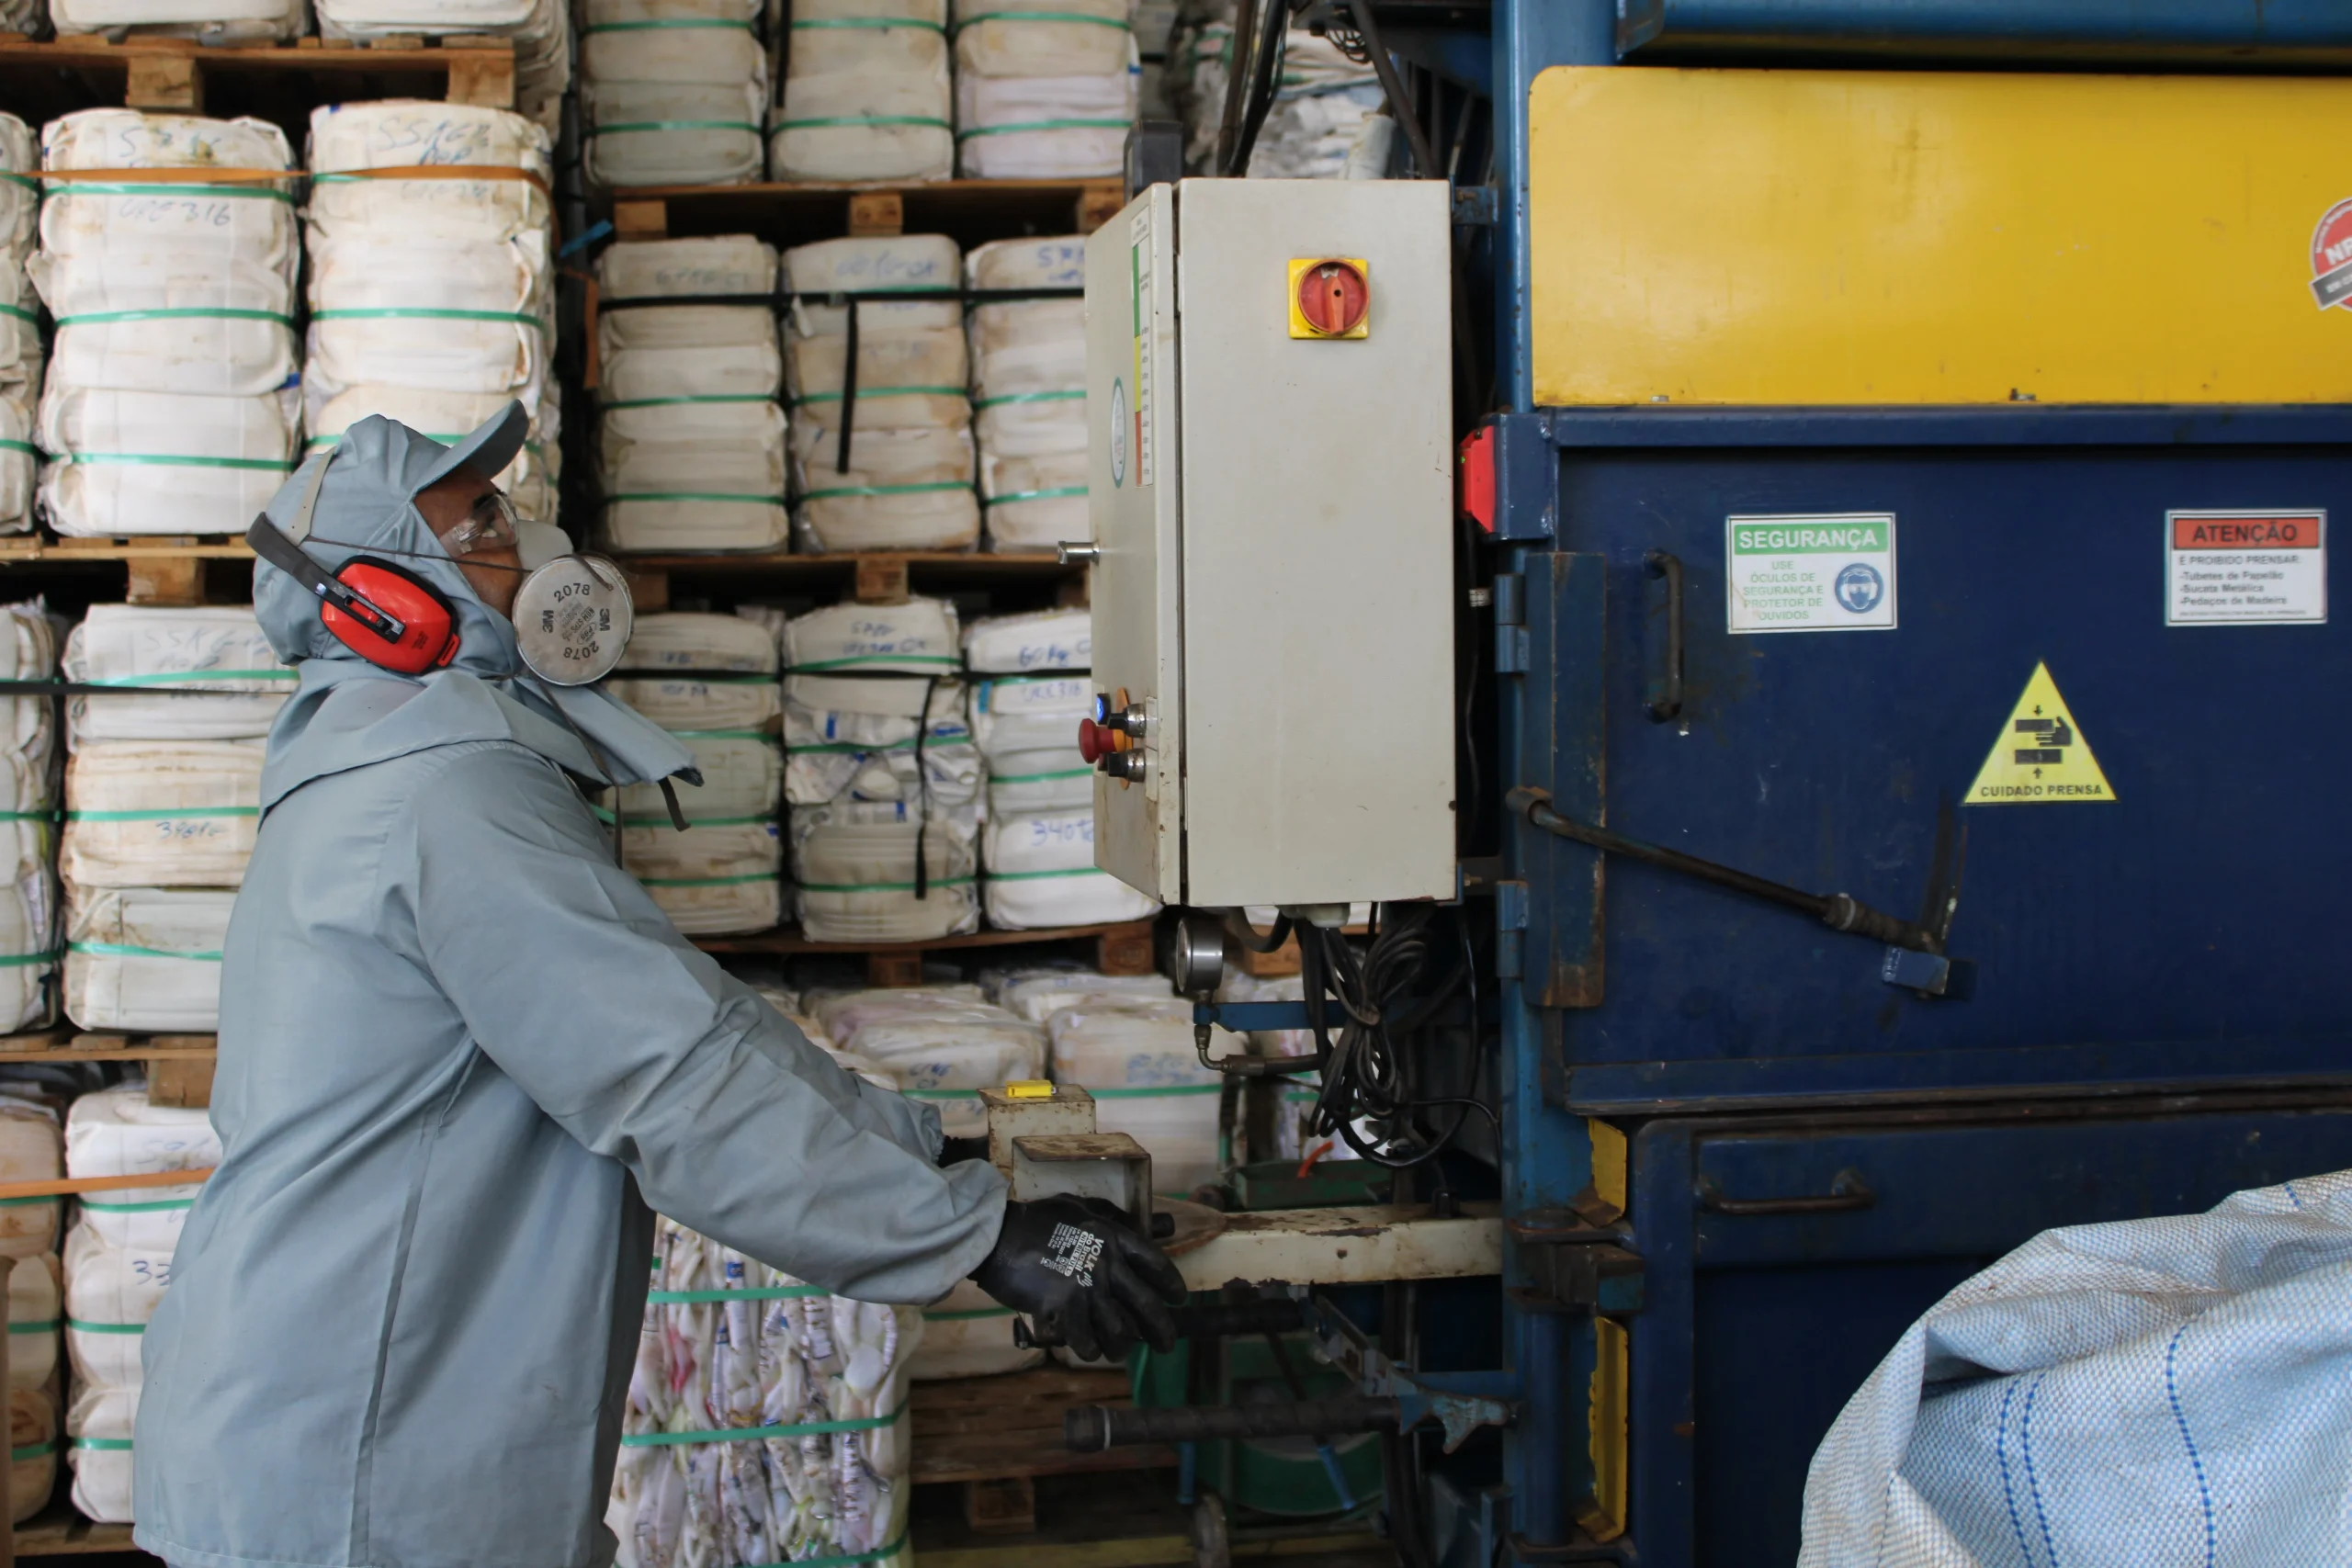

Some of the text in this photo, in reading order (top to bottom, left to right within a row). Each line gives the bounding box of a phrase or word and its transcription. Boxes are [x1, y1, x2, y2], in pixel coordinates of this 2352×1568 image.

[1739, 529, 1878, 550] SEGURANÇA
[2192, 521, 2298, 546] ATENÇÃO
[1771, 560, 1794, 570] USE
[2189, 555, 2244, 565] PROIBIDO
[1750, 570, 1815, 583] ÓCULOS DE
[2227, 571, 2239, 581] de
[2243, 570, 2284, 582] Papelão
[554, 583, 591, 603] 2078
[1743, 584, 1824, 597] SEGURANÇA E
[2222, 582, 2265, 593] Metálica
[1745, 598, 1824, 609] PROTETOR DE
[2231, 596, 2243, 605] de
[2246, 595, 2288, 605] Madeira
[542, 610, 555, 634] 3M
[599, 608, 611, 632] 3M
[1758, 610, 1810, 621] OUVIDOS
[563, 640, 600, 660] 2078
[1981, 784, 2103, 797] CUIDADO PRENSA
[1075, 1233, 1094, 1272] do Brasil
[1083, 1238, 1104, 1272] VOLK
